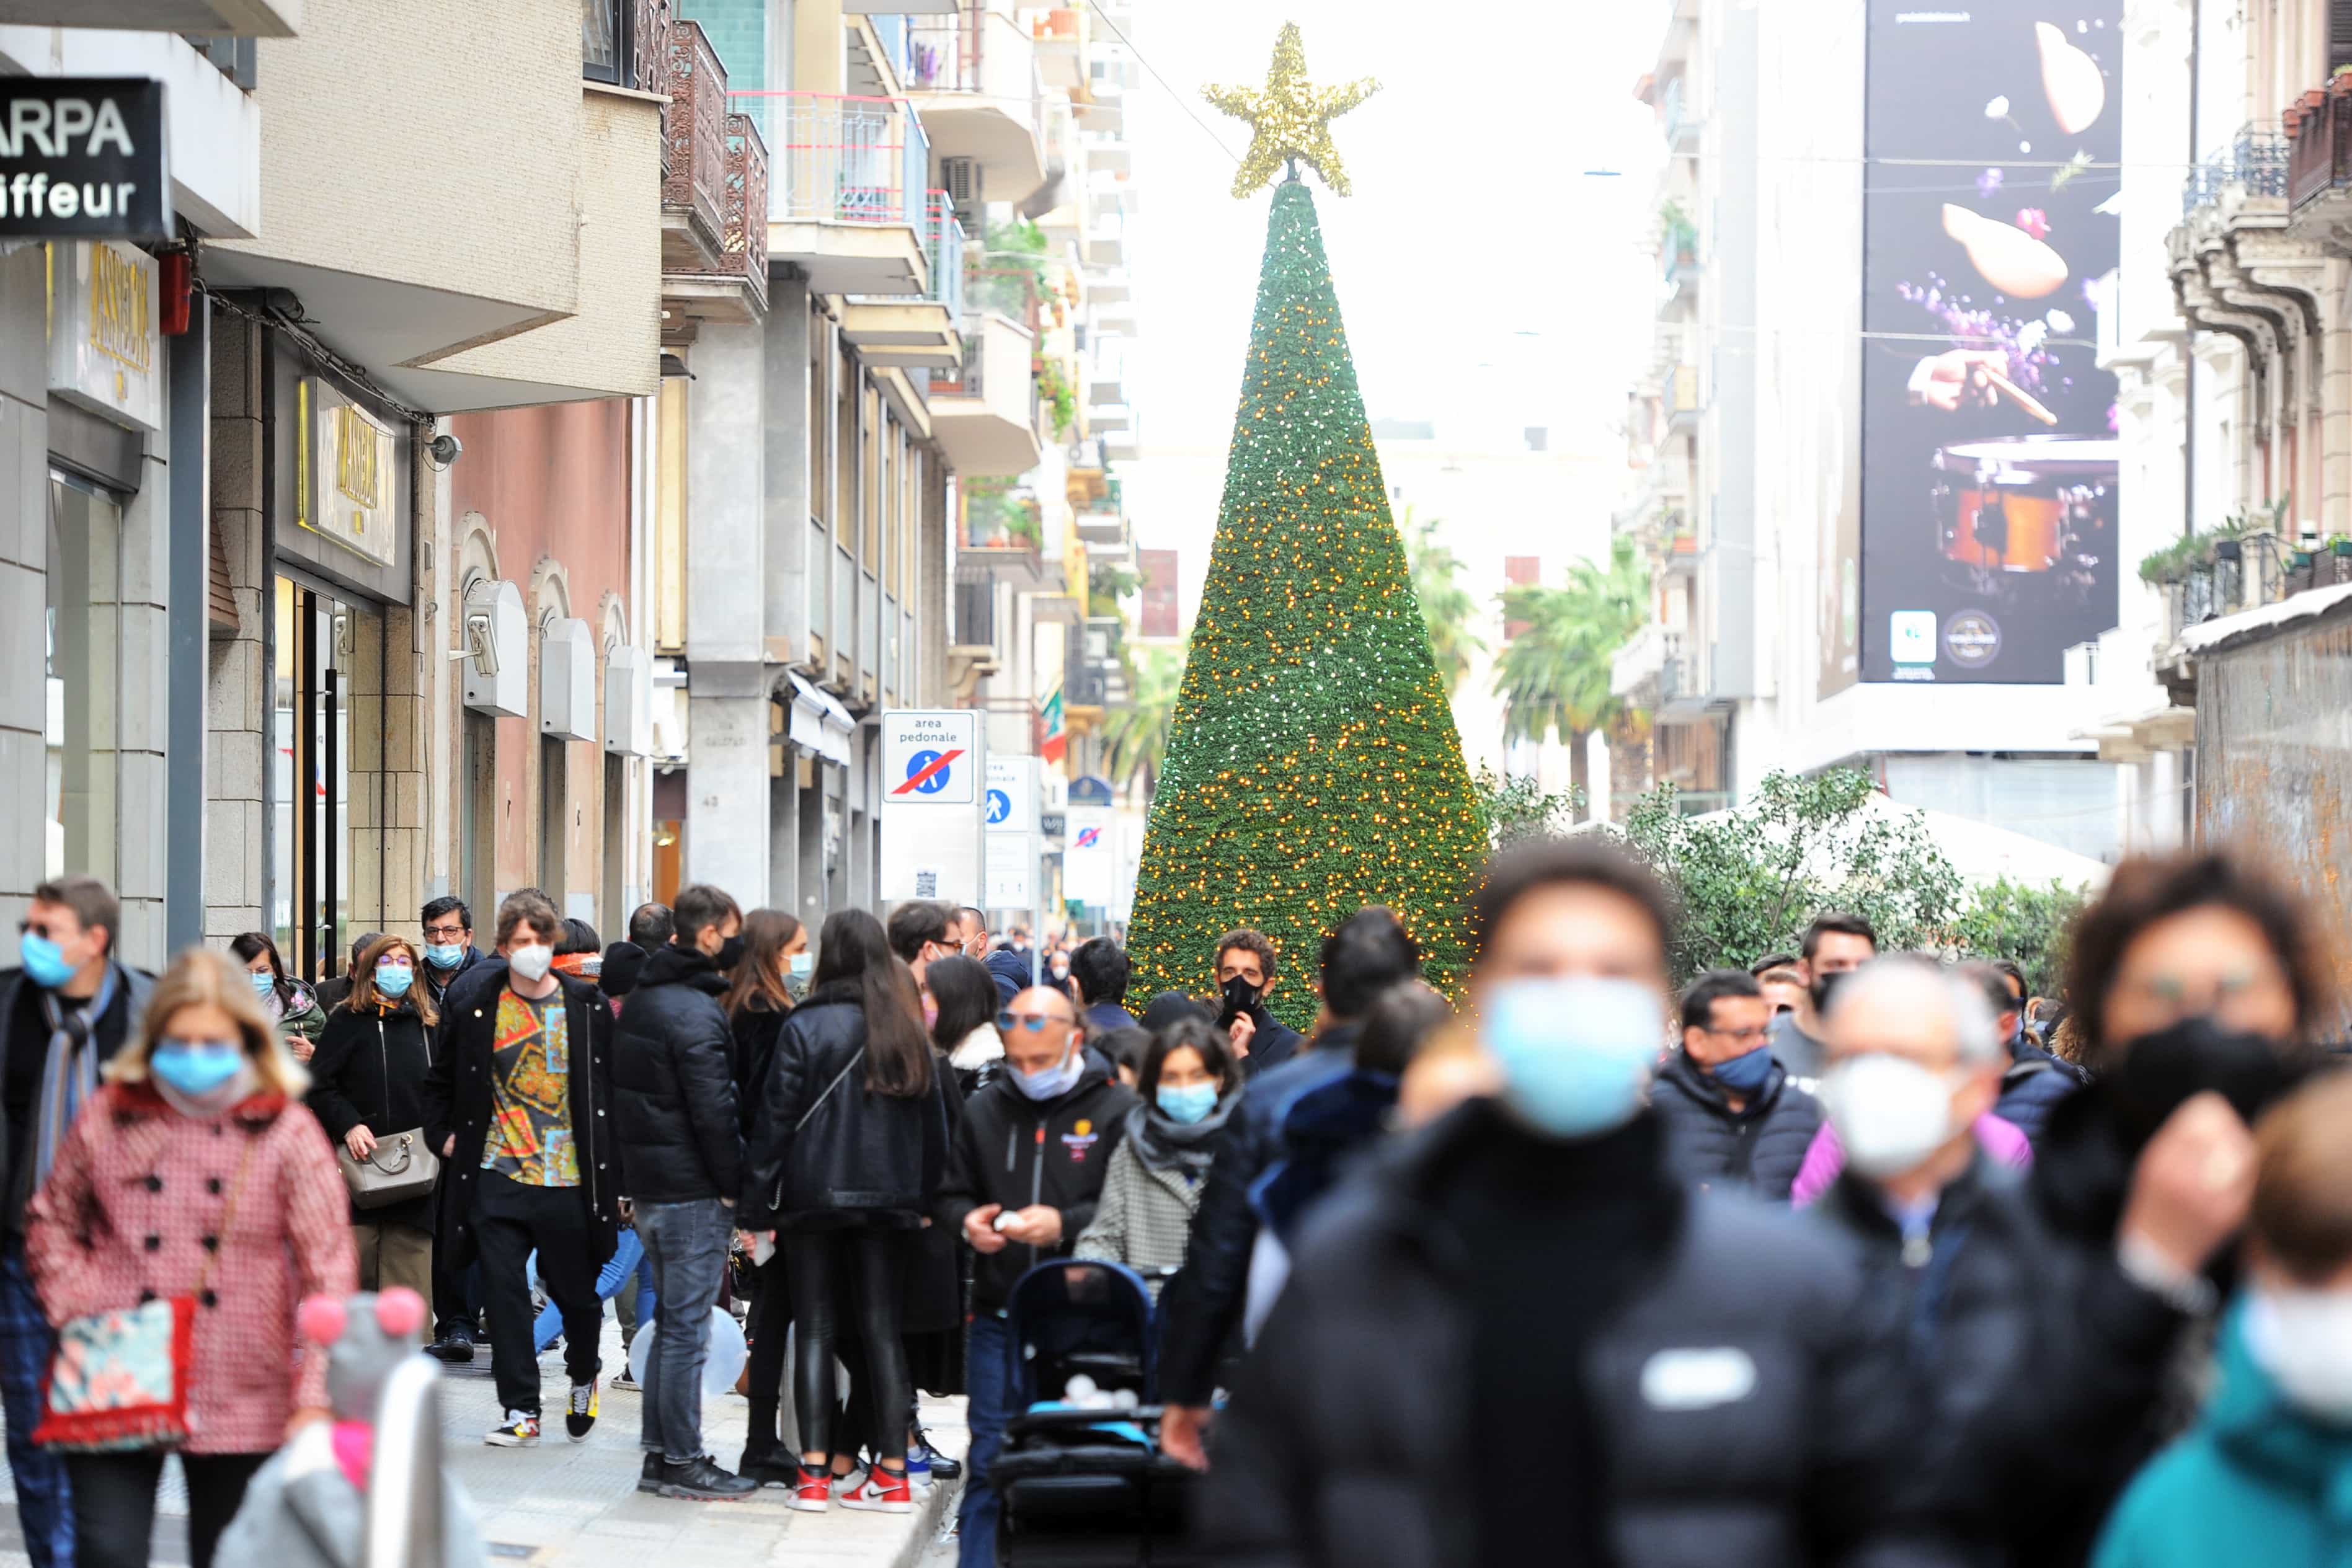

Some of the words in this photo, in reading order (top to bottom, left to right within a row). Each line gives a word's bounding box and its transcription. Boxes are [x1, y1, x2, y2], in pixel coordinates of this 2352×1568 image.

[0, 98, 135, 156] RPA
[915, 720, 942, 728] area
[900, 732, 957, 743] pedonale
